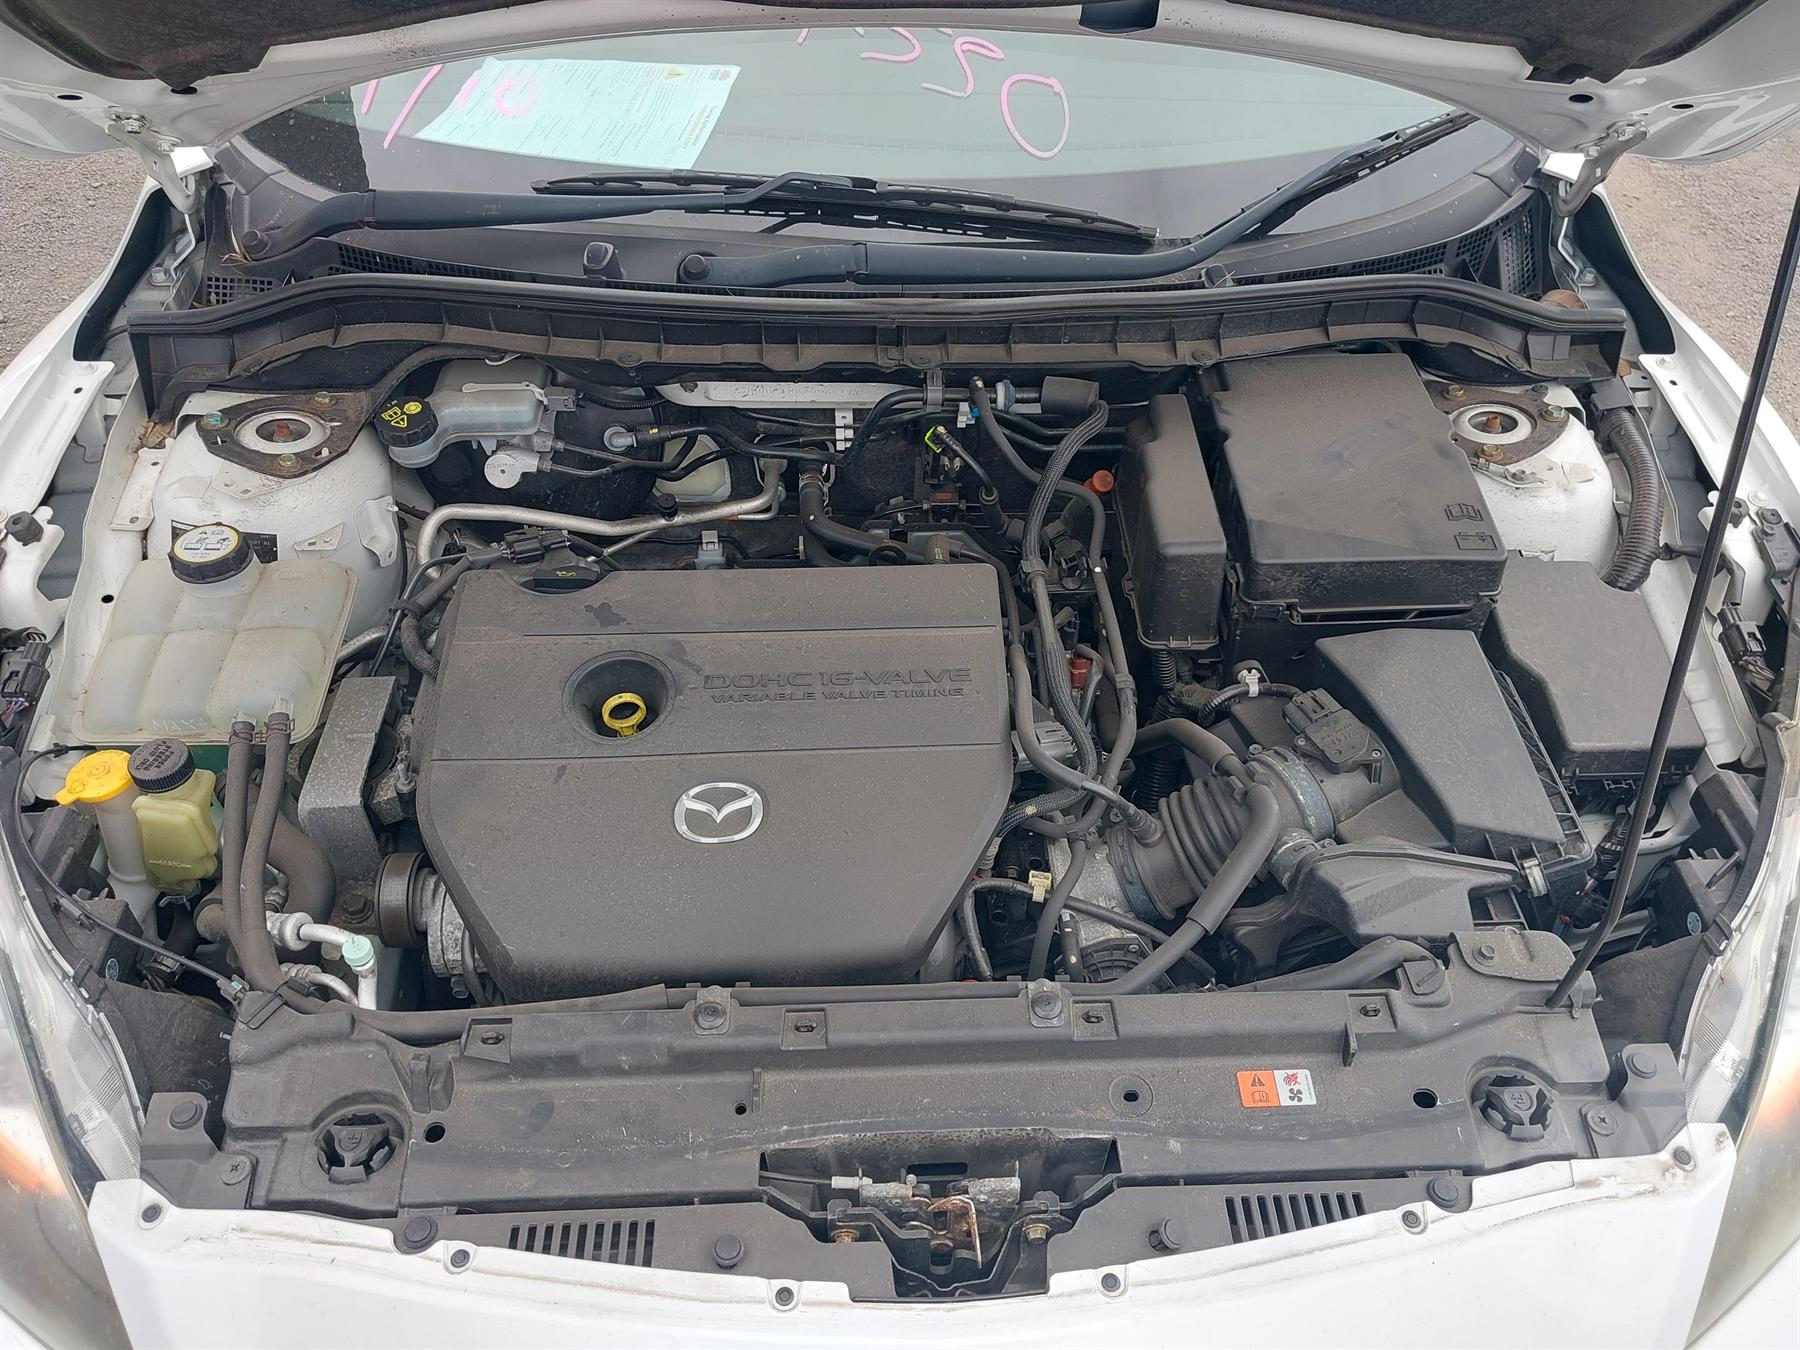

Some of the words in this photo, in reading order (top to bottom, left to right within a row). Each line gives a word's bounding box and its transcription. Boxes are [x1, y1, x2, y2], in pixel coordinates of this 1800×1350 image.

[703, 671, 814, 690] DOHC
[818, 668, 973, 687] 16-VALVE
[710, 691, 817, 704] VARIABLE
[821, 689, 889, 701] VALVE
[890, 687, 965, 699] TIMING
[149, 740, 168, 757] FLUID
[134, 757, 150, 771] ONLY
[142, 744, 172, 771] STEERING
[154, 751, 175, 769] POWER
